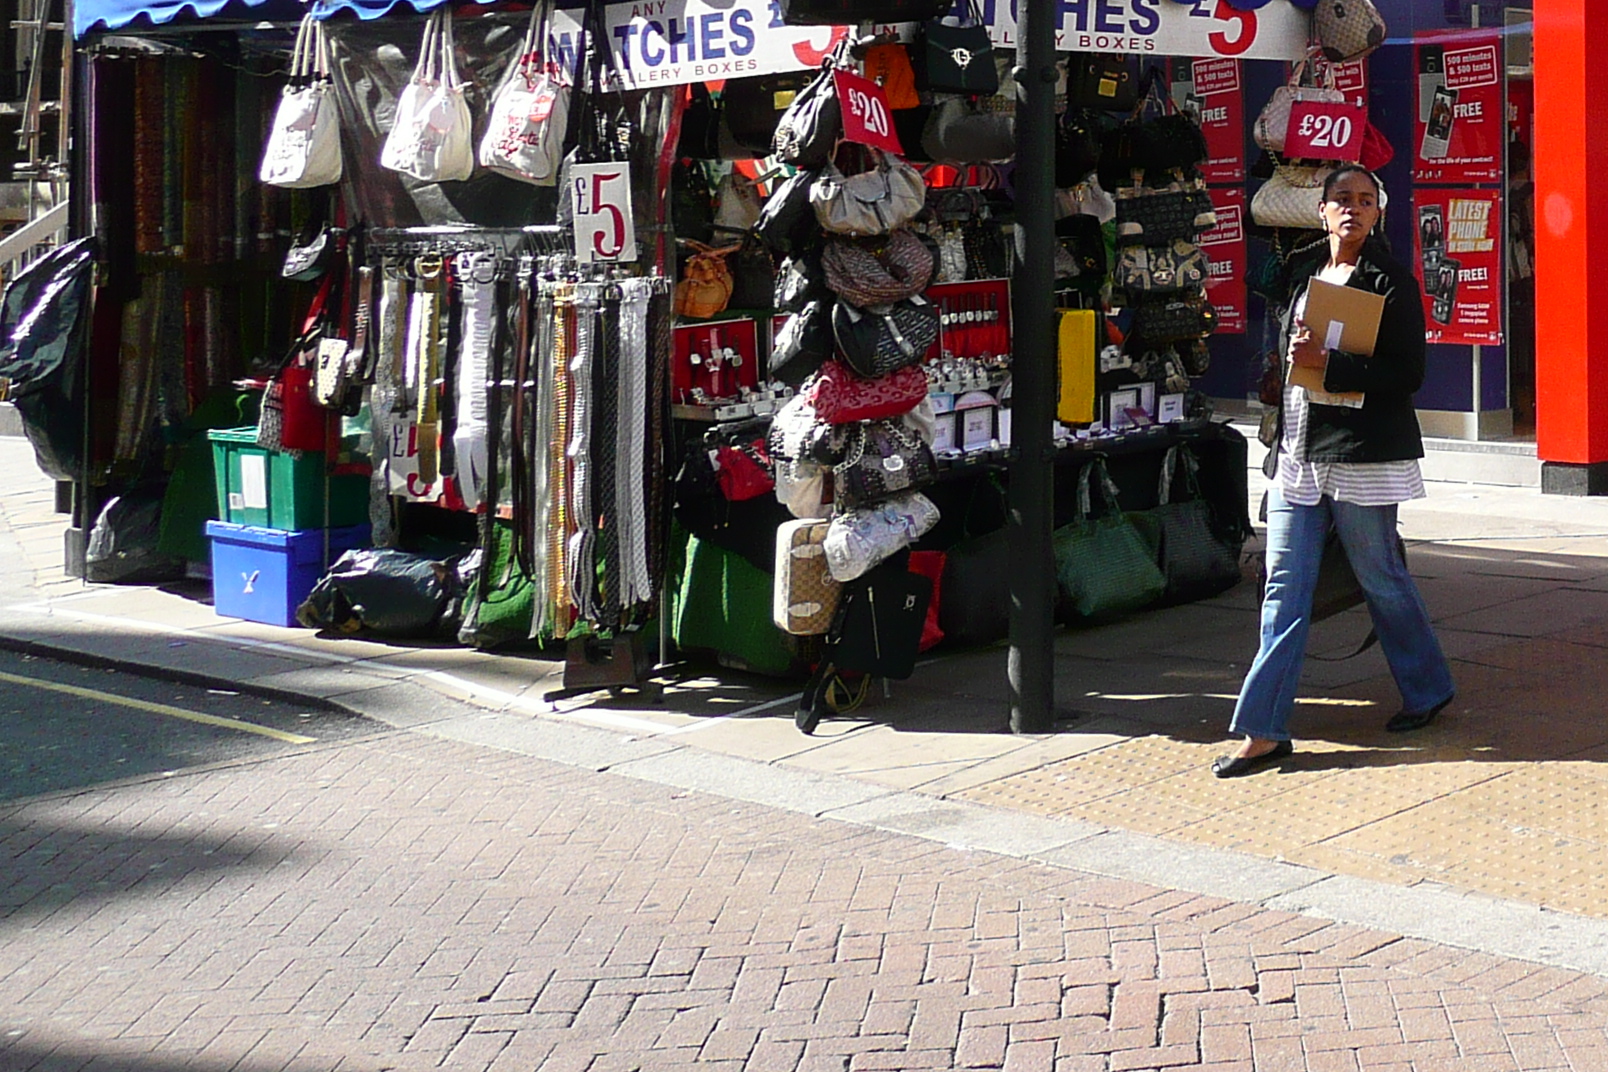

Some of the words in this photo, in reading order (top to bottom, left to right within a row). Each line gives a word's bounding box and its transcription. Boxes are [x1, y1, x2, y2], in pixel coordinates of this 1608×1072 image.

[631, 0, 666, 19] ANY
[549, 8, 755, 78] WTCHES
[1079, 34, 1155, 51] BOXES
[694, 58, 758, 76] BOXES
[848, 88, 888, 137] £20
[1201, 107, 1228, 123] FREE
[1453, 101, 1483, 118] FREE
[1298, 114, 1352, 148] £20
[575, 172, 625, 257] £5
[1448, 200, 1492, 220] LATEST
[1448, 220, 1488, 239] PHONE
[1458, 267, 1488, 282] FREE!
